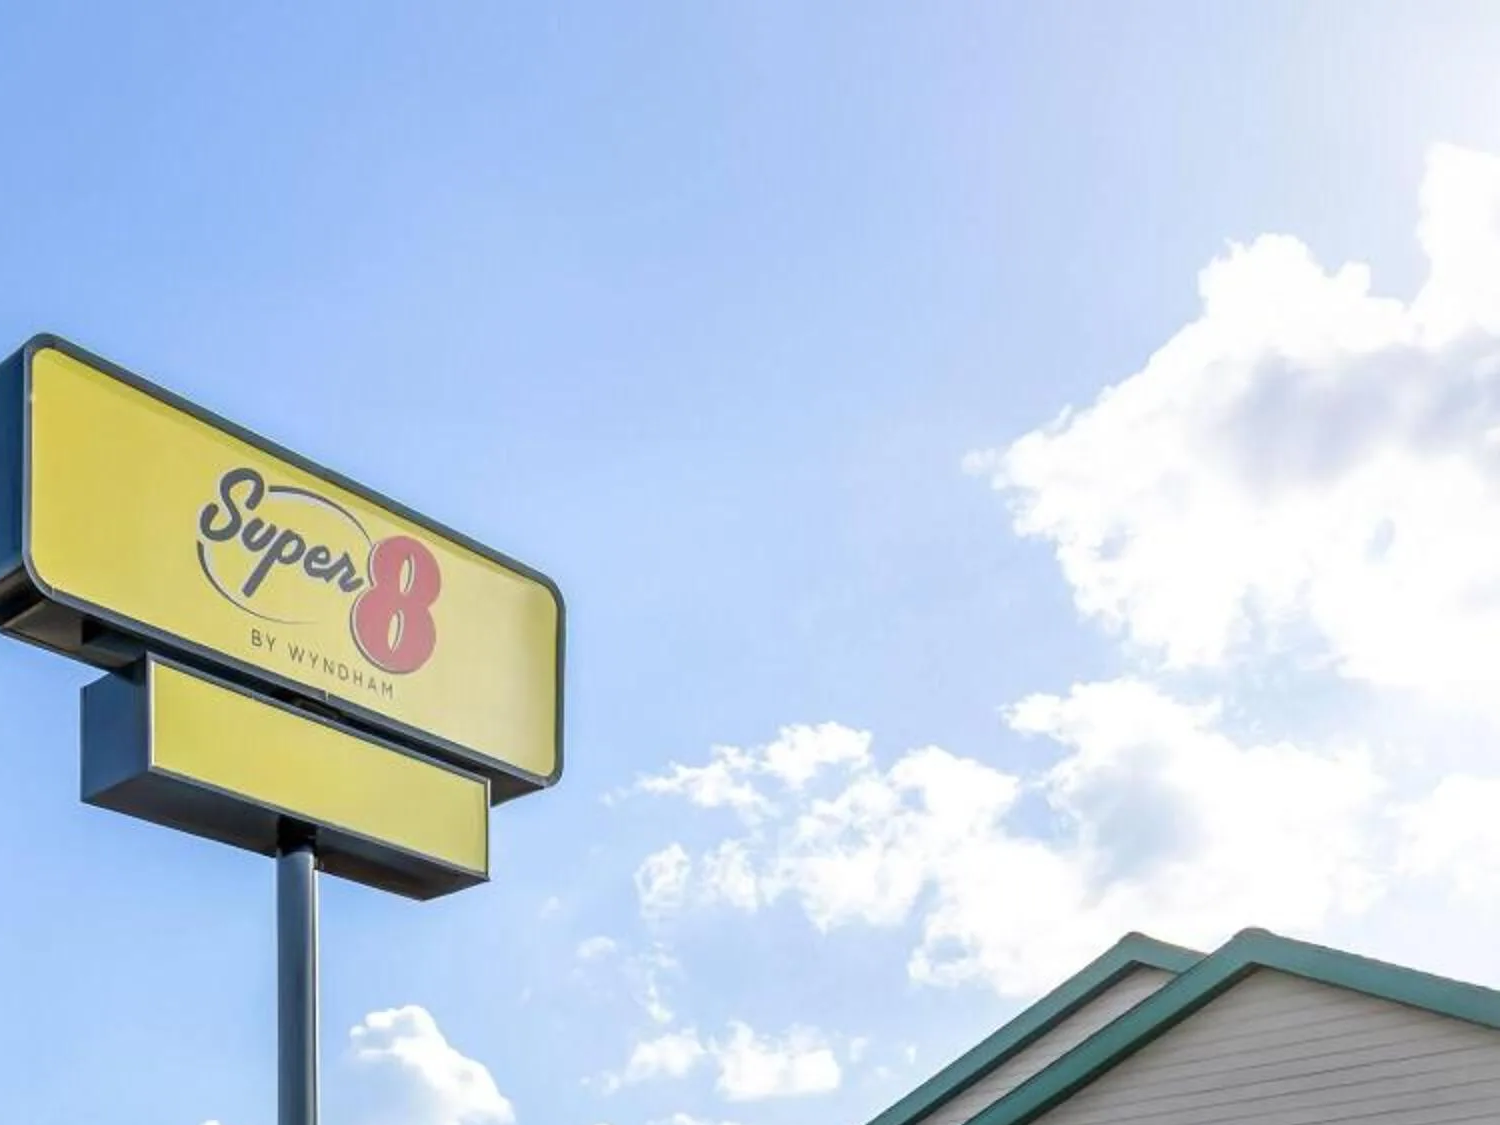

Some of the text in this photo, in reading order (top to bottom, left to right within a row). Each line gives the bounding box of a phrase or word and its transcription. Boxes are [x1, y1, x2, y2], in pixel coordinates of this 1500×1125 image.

[200, 468, 441, 675] Super 8
[251, 629, 393, 697] BY WYNDHAM
